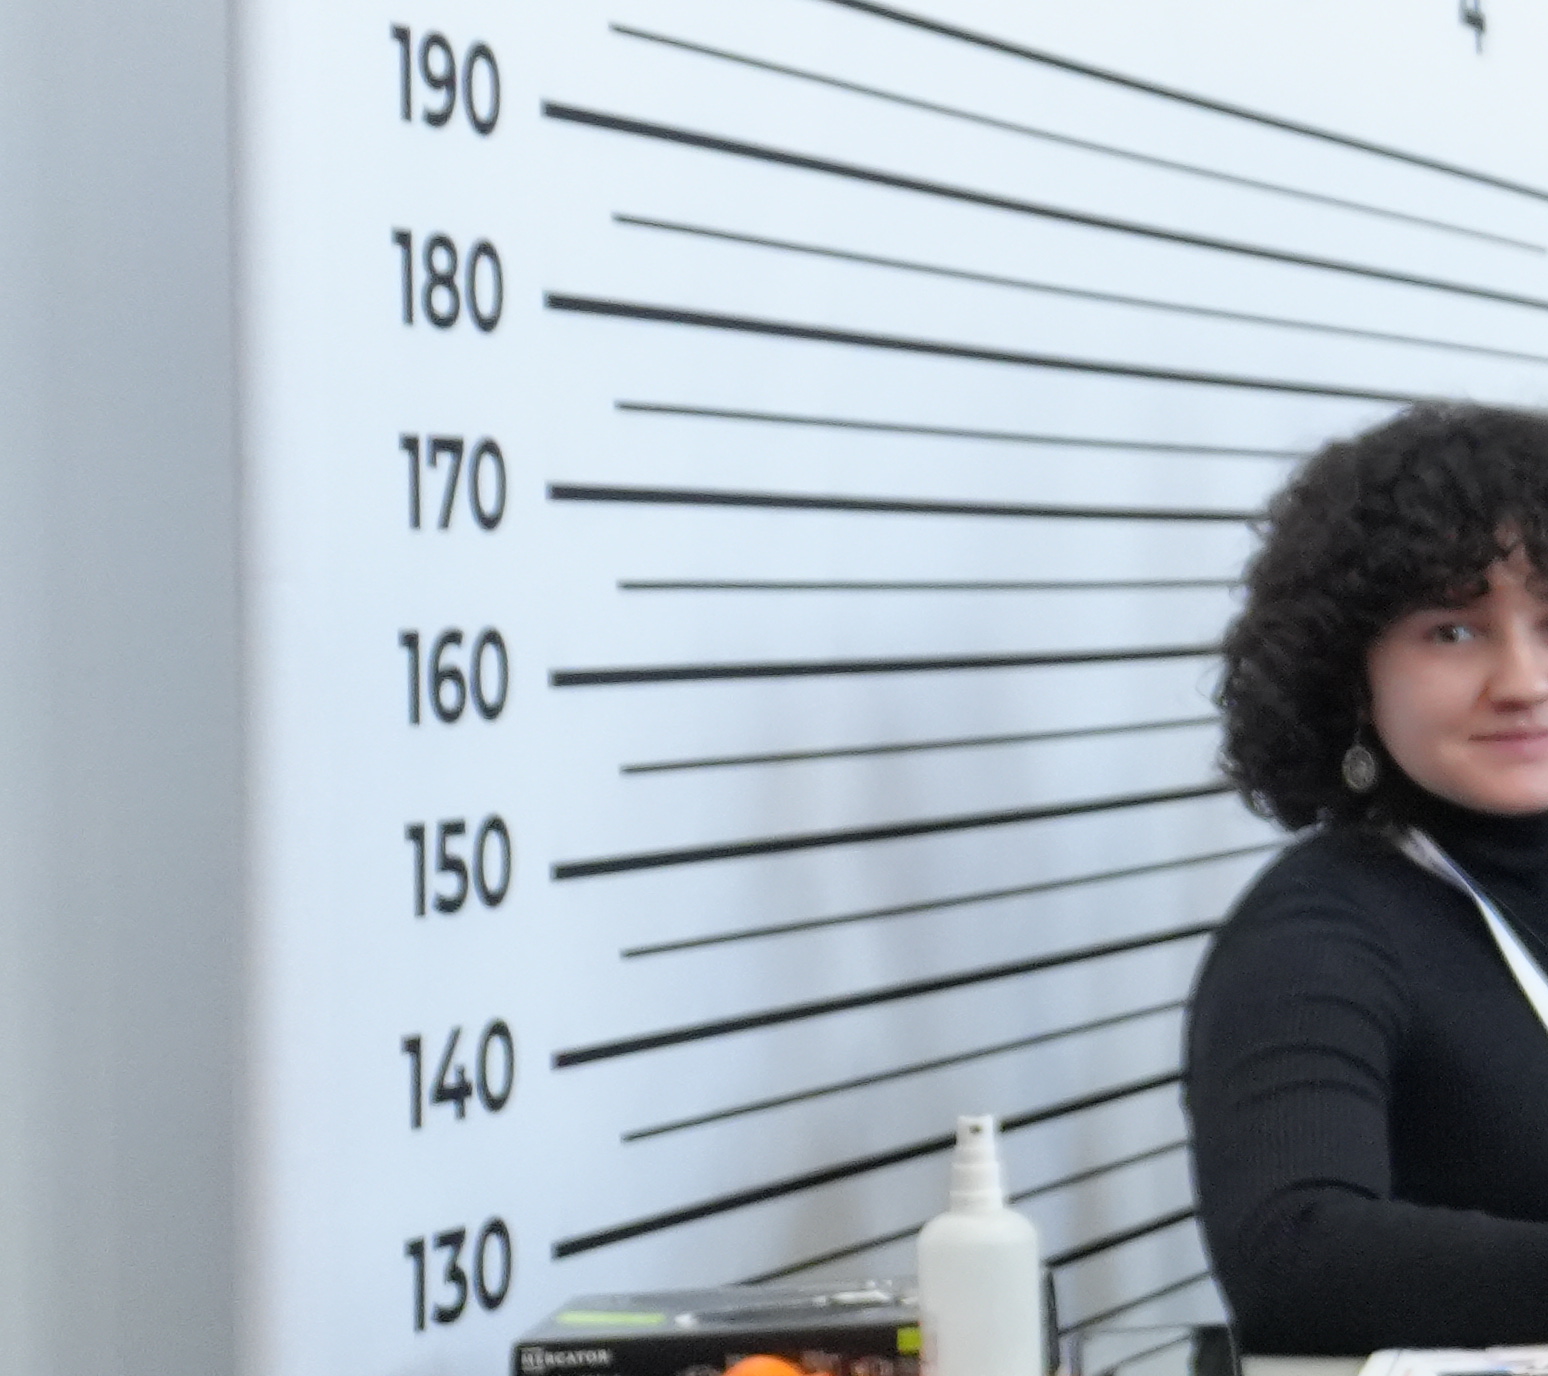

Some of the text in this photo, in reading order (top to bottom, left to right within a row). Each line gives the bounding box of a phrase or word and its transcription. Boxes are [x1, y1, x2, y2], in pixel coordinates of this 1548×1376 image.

[390, 24, 502, 138] 190
[391, 228, 505, 334] 180
[399, 434, 508, 532] 170
[399, 627, 510, 727] 160
[405, 814, 513, 918] 150
[400, 1019, 516, 1130] 140
[404, 1217, 513, 1336] 130
